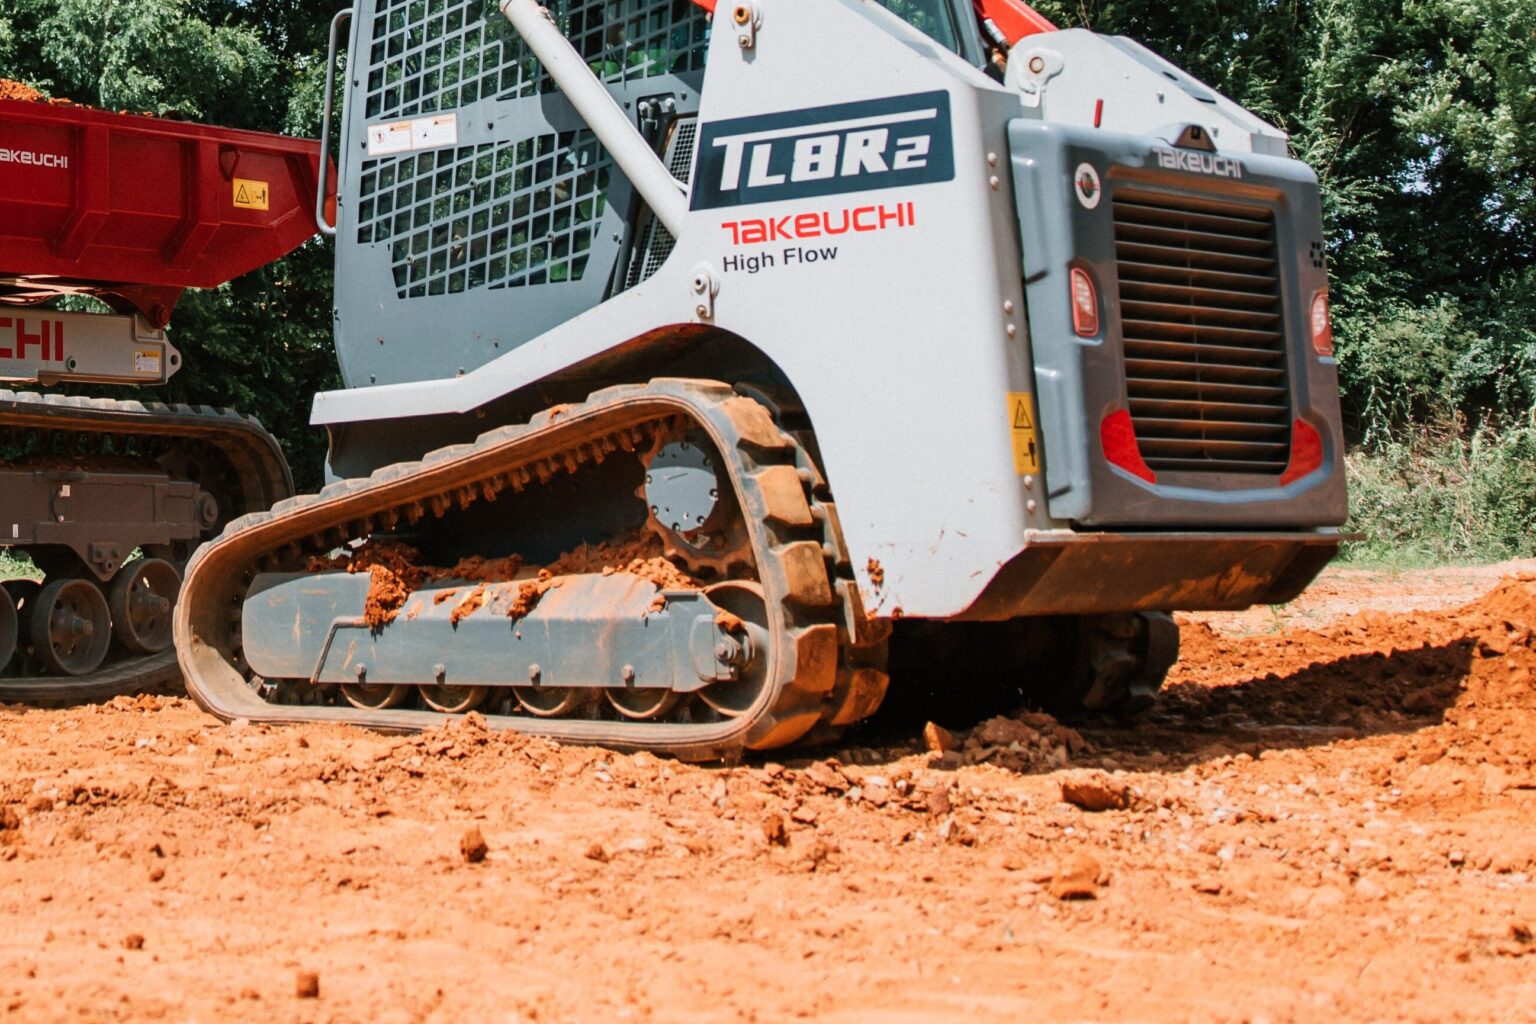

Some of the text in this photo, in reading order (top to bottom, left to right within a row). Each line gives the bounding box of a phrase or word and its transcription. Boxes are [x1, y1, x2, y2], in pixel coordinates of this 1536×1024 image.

[712, 108, 938, 192] TL8R2
[1152, 147, 1242, 179] TAKEUCHI
[721, 201, 915, 246] TAKEUCHI
[722, 246, 838, 274] High Flow
